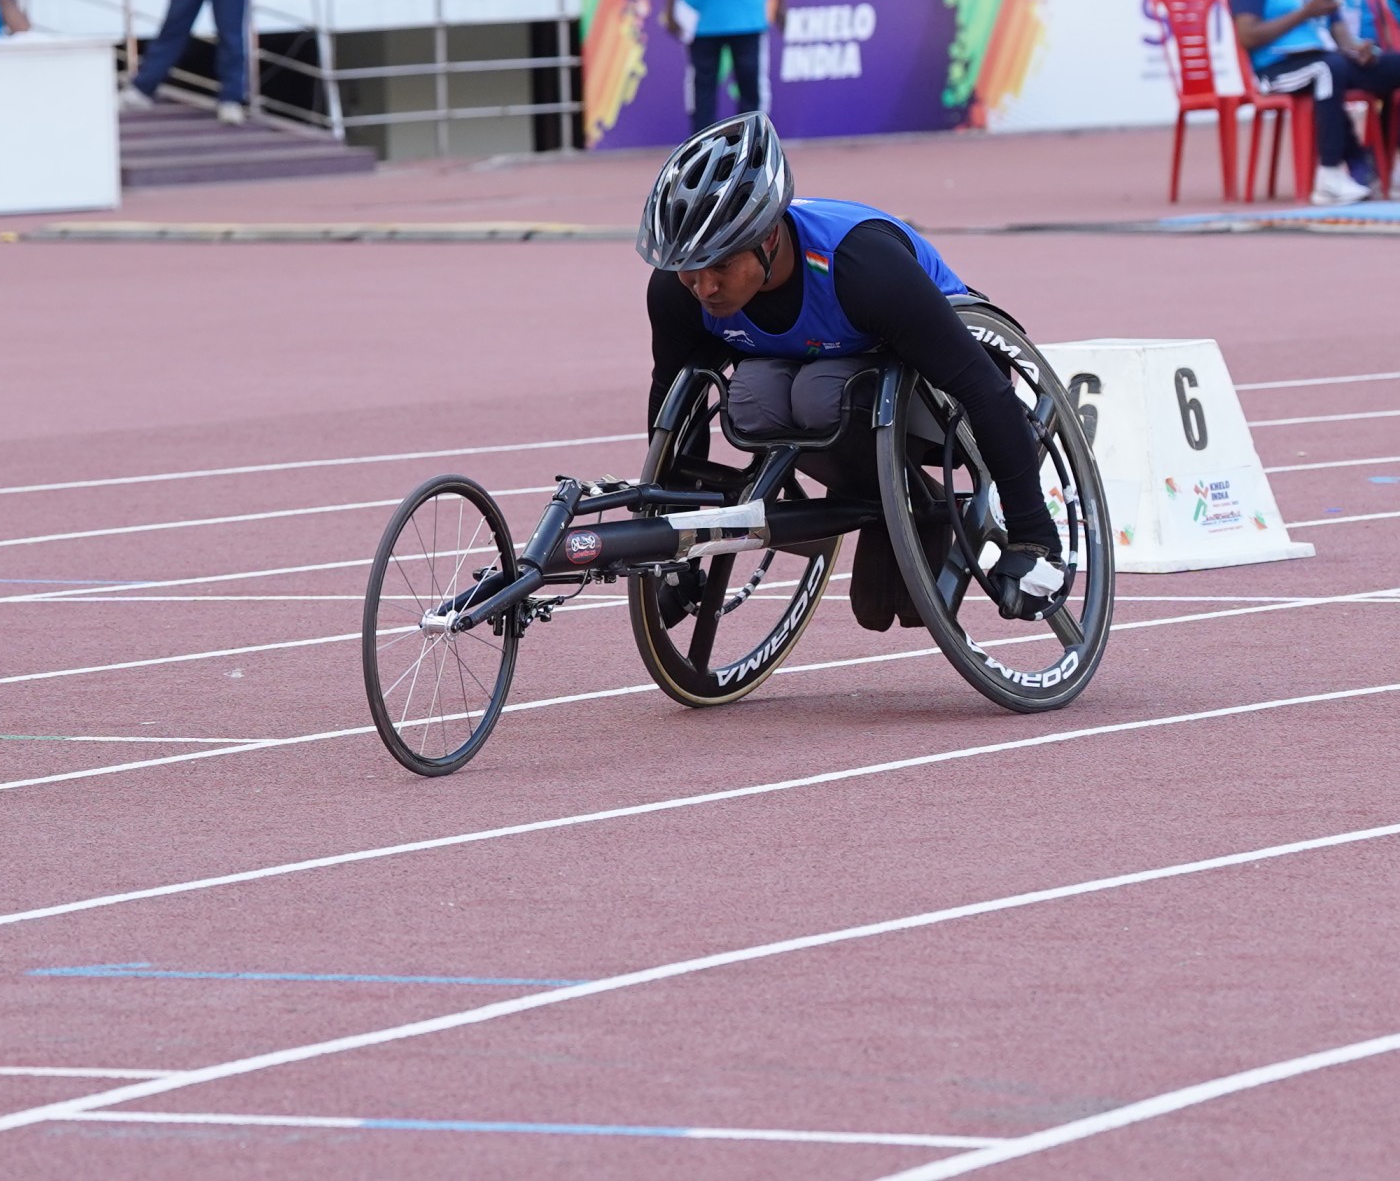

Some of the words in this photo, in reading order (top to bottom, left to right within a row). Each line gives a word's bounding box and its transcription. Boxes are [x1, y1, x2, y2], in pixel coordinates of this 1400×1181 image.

[784, 3, 877, 42] KHELO
[781, 42, 862, 83] INDIA
[1067, 372, 1101, 450] 6
[1174, 367, 1208, 451] 6
[1209, 480, 1230, 491] KHELO
[1211, 491, 1229, 501] INDIA
[716, 554, 825, 687] CORIMA
